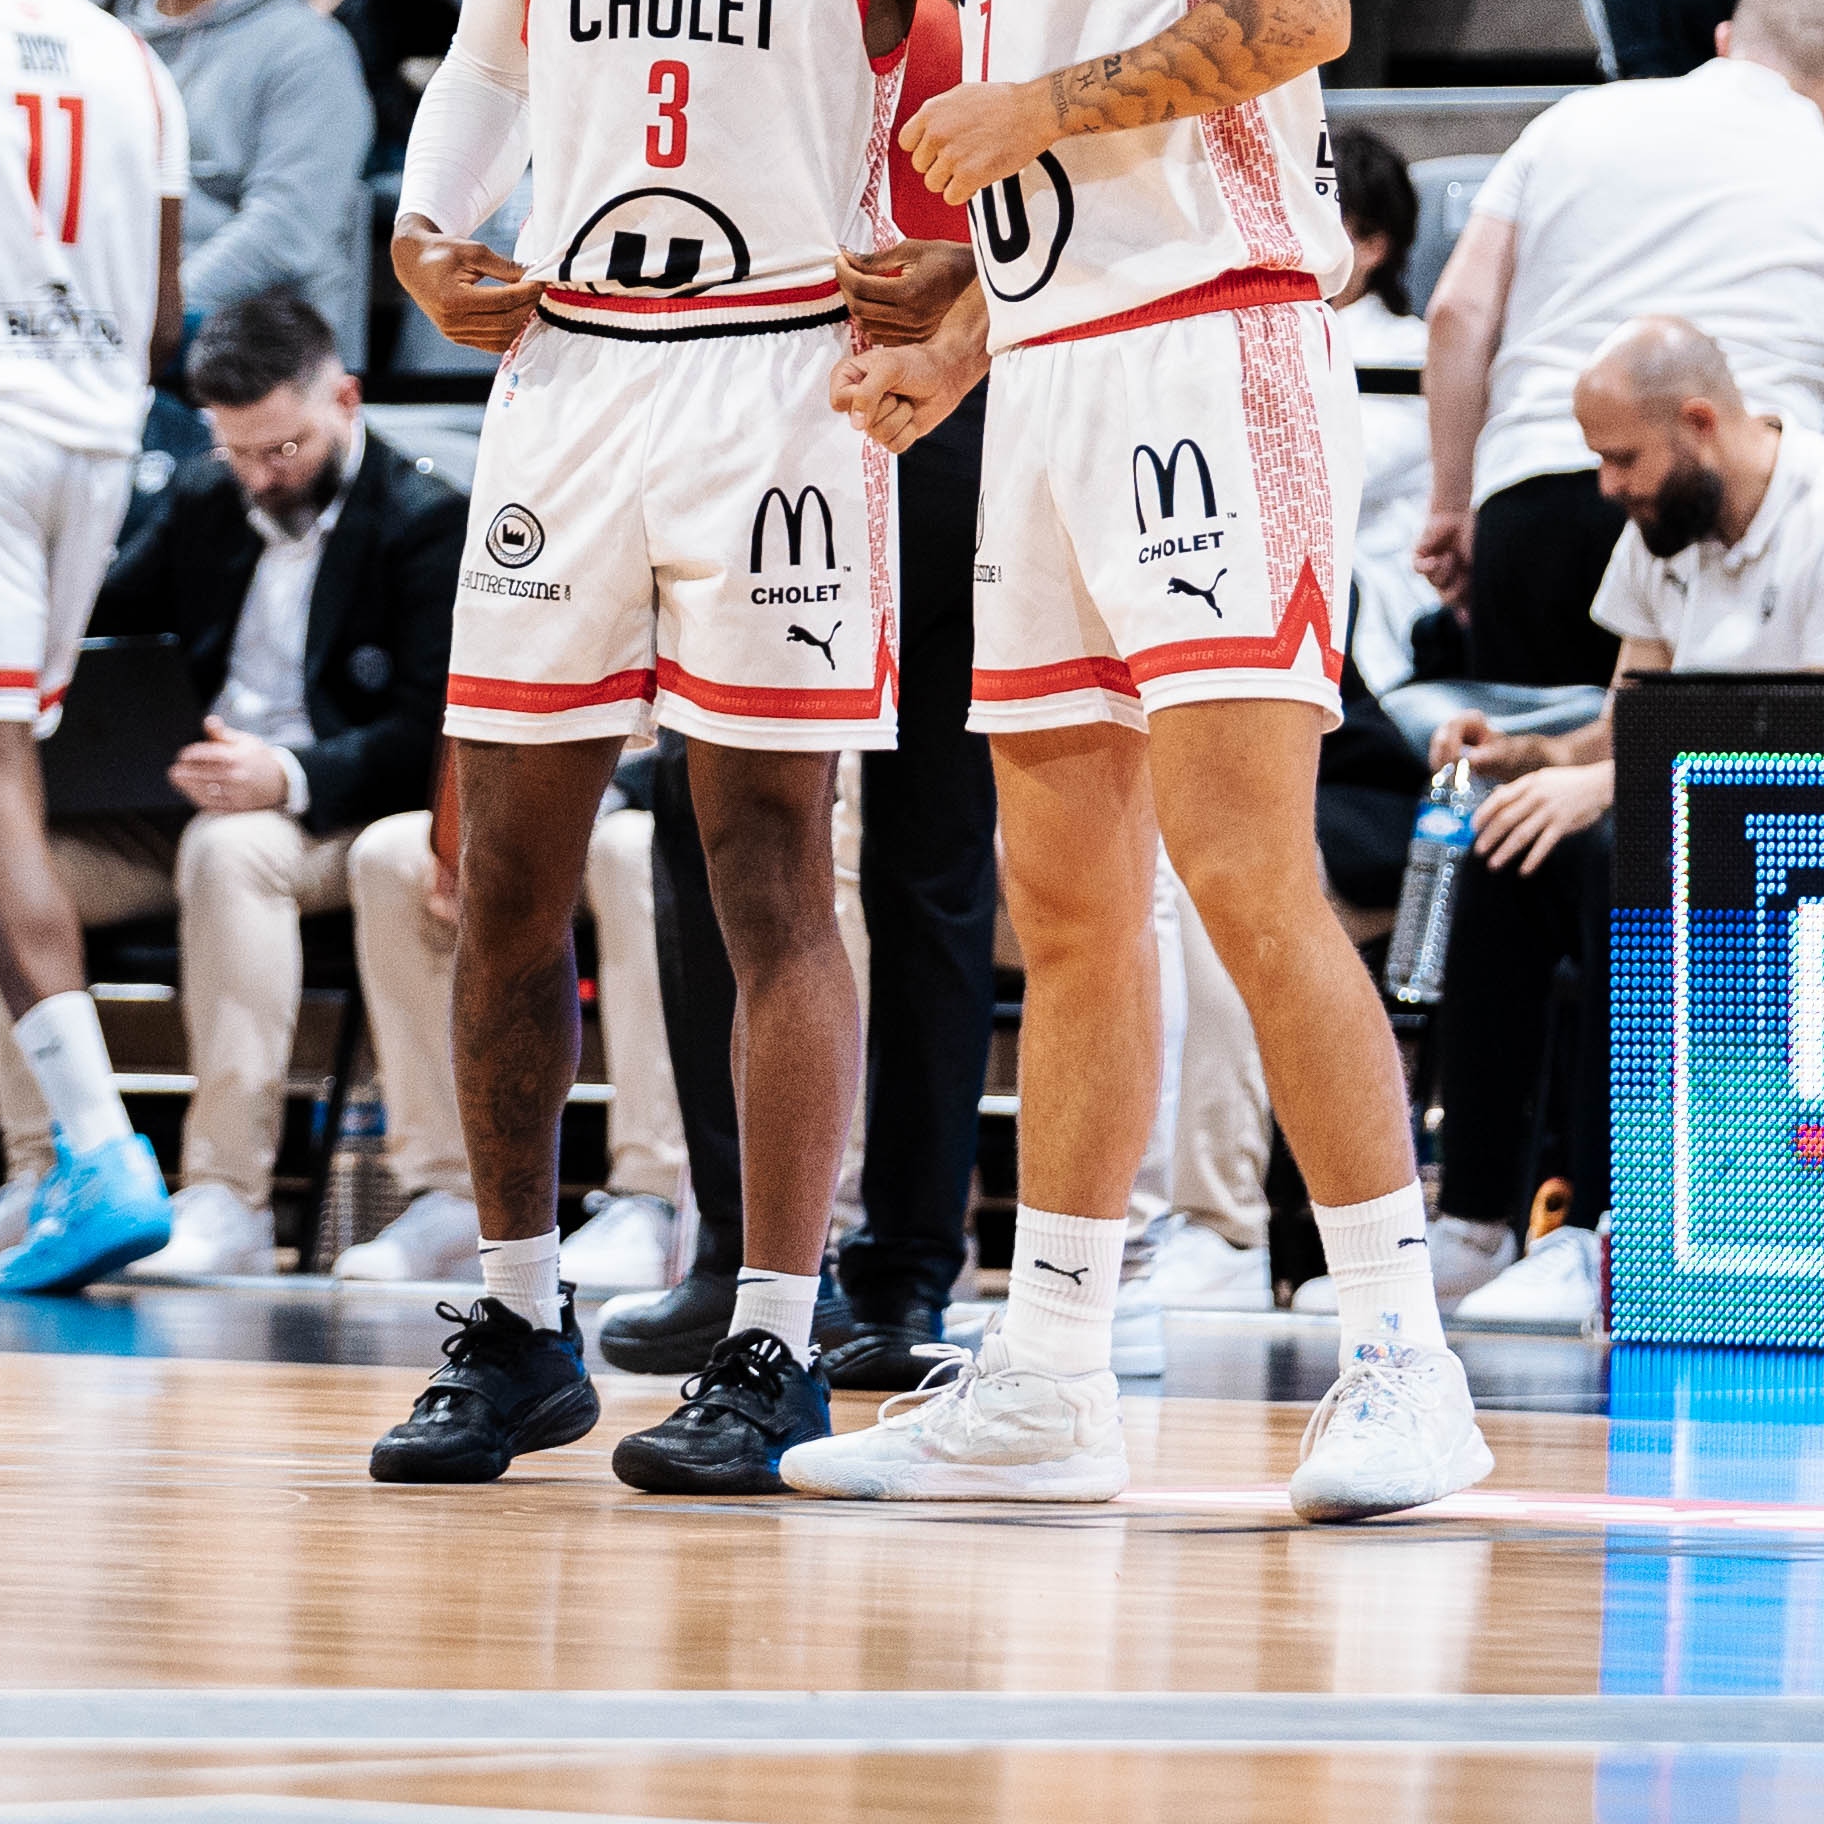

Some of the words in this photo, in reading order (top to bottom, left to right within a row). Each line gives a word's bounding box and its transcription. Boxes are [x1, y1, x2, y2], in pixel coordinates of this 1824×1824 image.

[645, 59, 690, 169] 3
[14, 92, 85, 245] 11
[1138, 531, 1224, 564] CHOLET
[751, 584, 842, 605] CHOLET
[1181, 649, 1214, 661] FASTER
